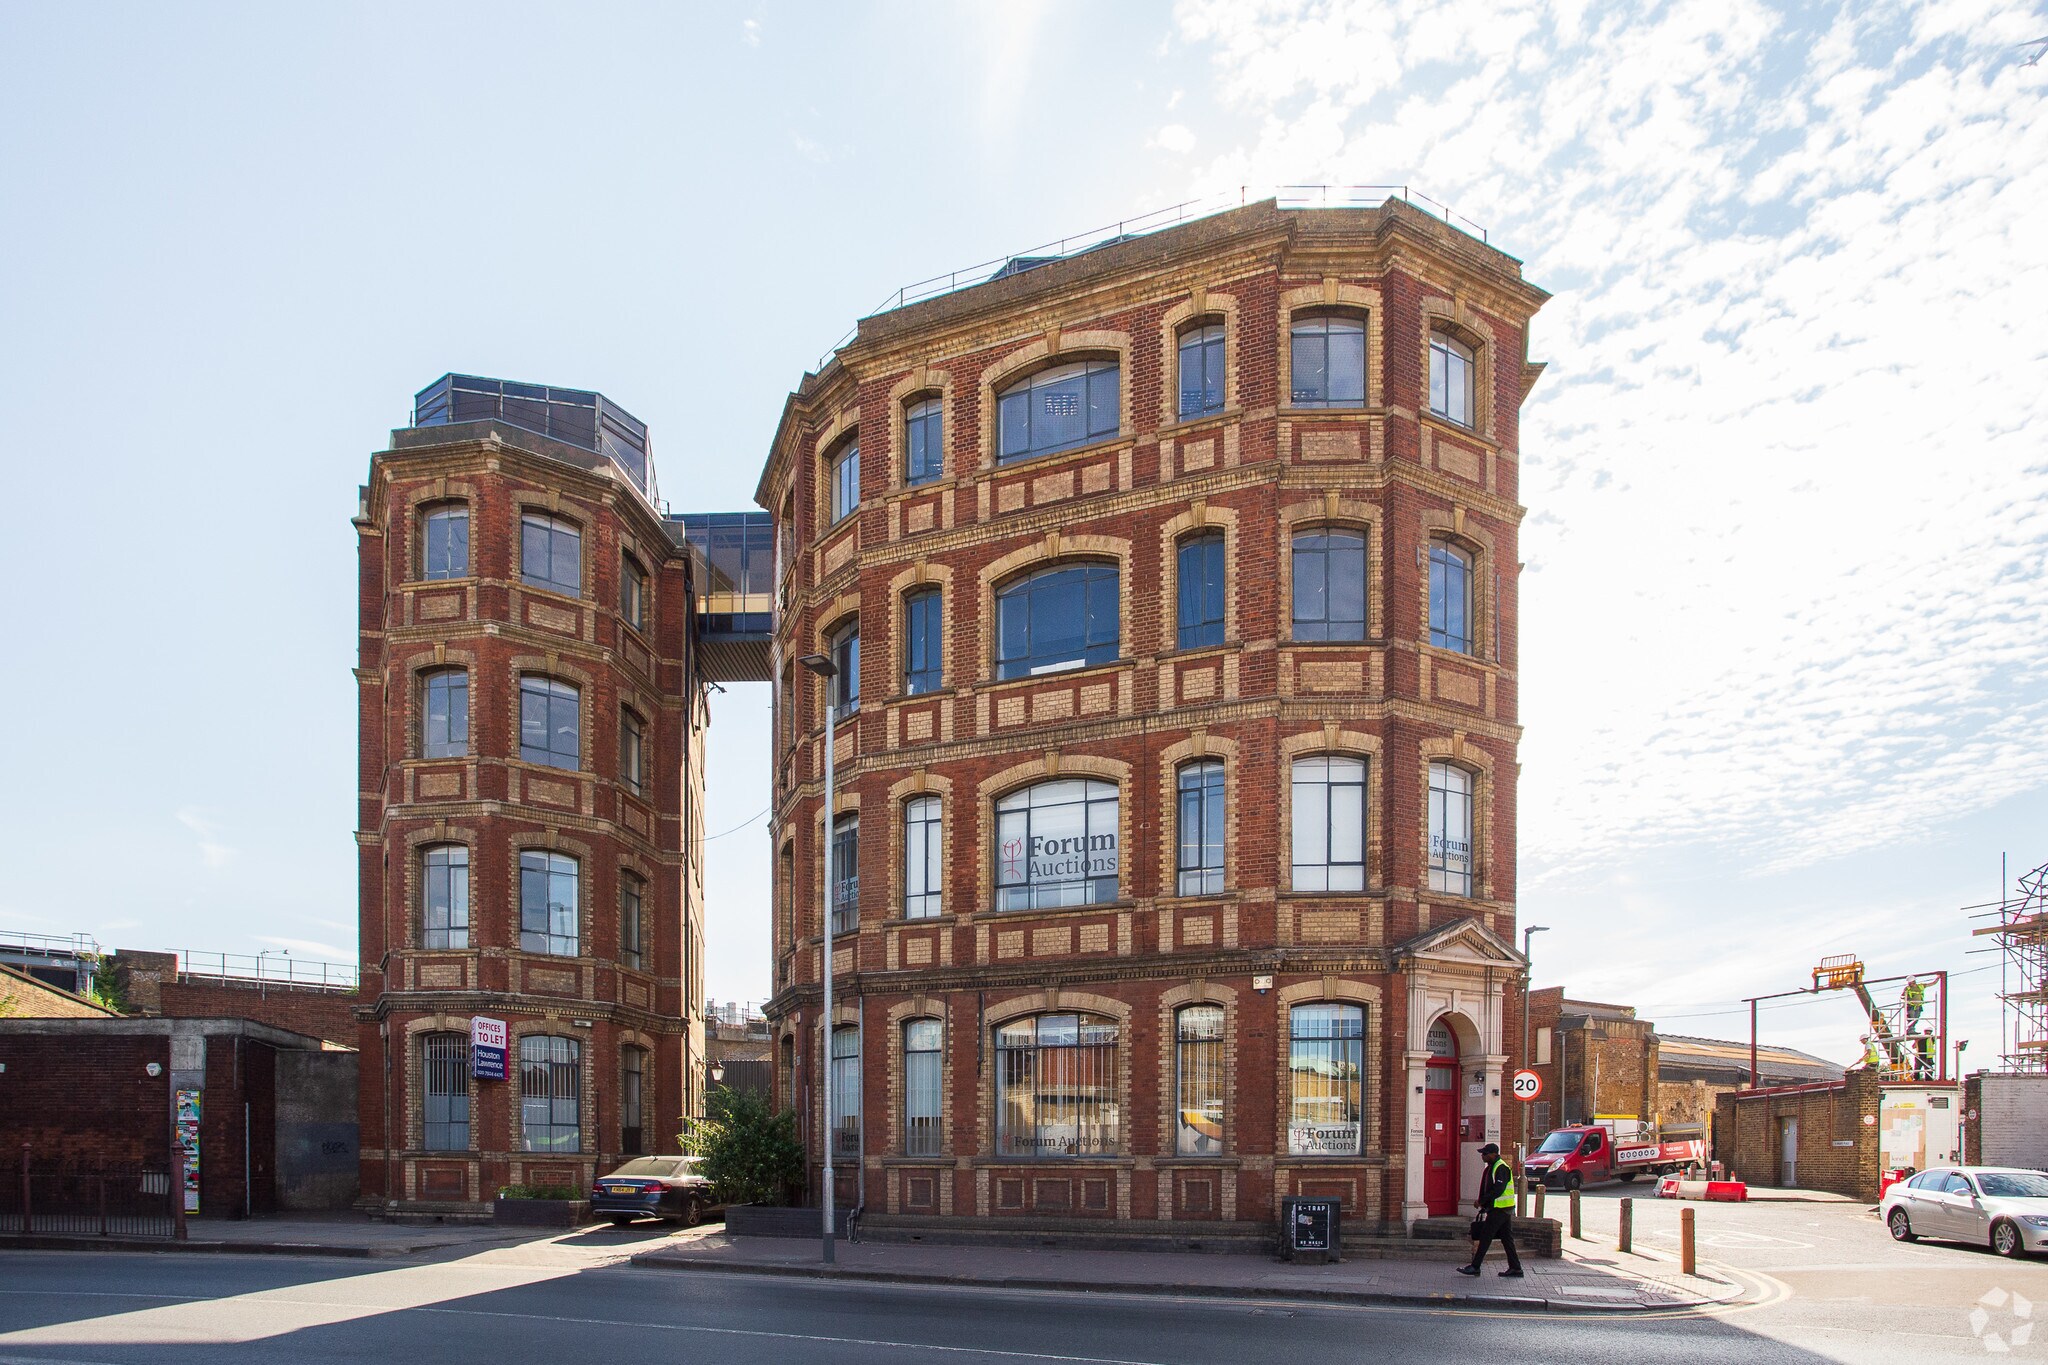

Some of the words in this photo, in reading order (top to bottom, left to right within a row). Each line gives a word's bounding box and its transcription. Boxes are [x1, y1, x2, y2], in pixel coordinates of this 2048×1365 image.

[1029, 833, 1115, 857] Forum
[1030, 856, 1116, 878] Auctions
[841, 881, 858, 892] Foru
[478, 1021, 501, 1032] OFFICES
[478, 1032, 489, 1043] TO
[490, 1034, 504, 1045] LET
[1428, 1030, 1447, 1039] rum
[1427, 1039, 1448, 1048] ctions
[477, 1049, 501, 1060] Houston
[477, 1058, 504, 1069] Lawrence
[1515, 1079, 1536, 1091] 20
[842, 1132, 859, 1142] Foru
[1307, 1127, 1356, 1139] Forum
[1014, 1137, 1056, 1147] Forum
[1058, 1135, 1115, 1149] Auctions
[1307, 1139, 1356, 1150] Auctions
